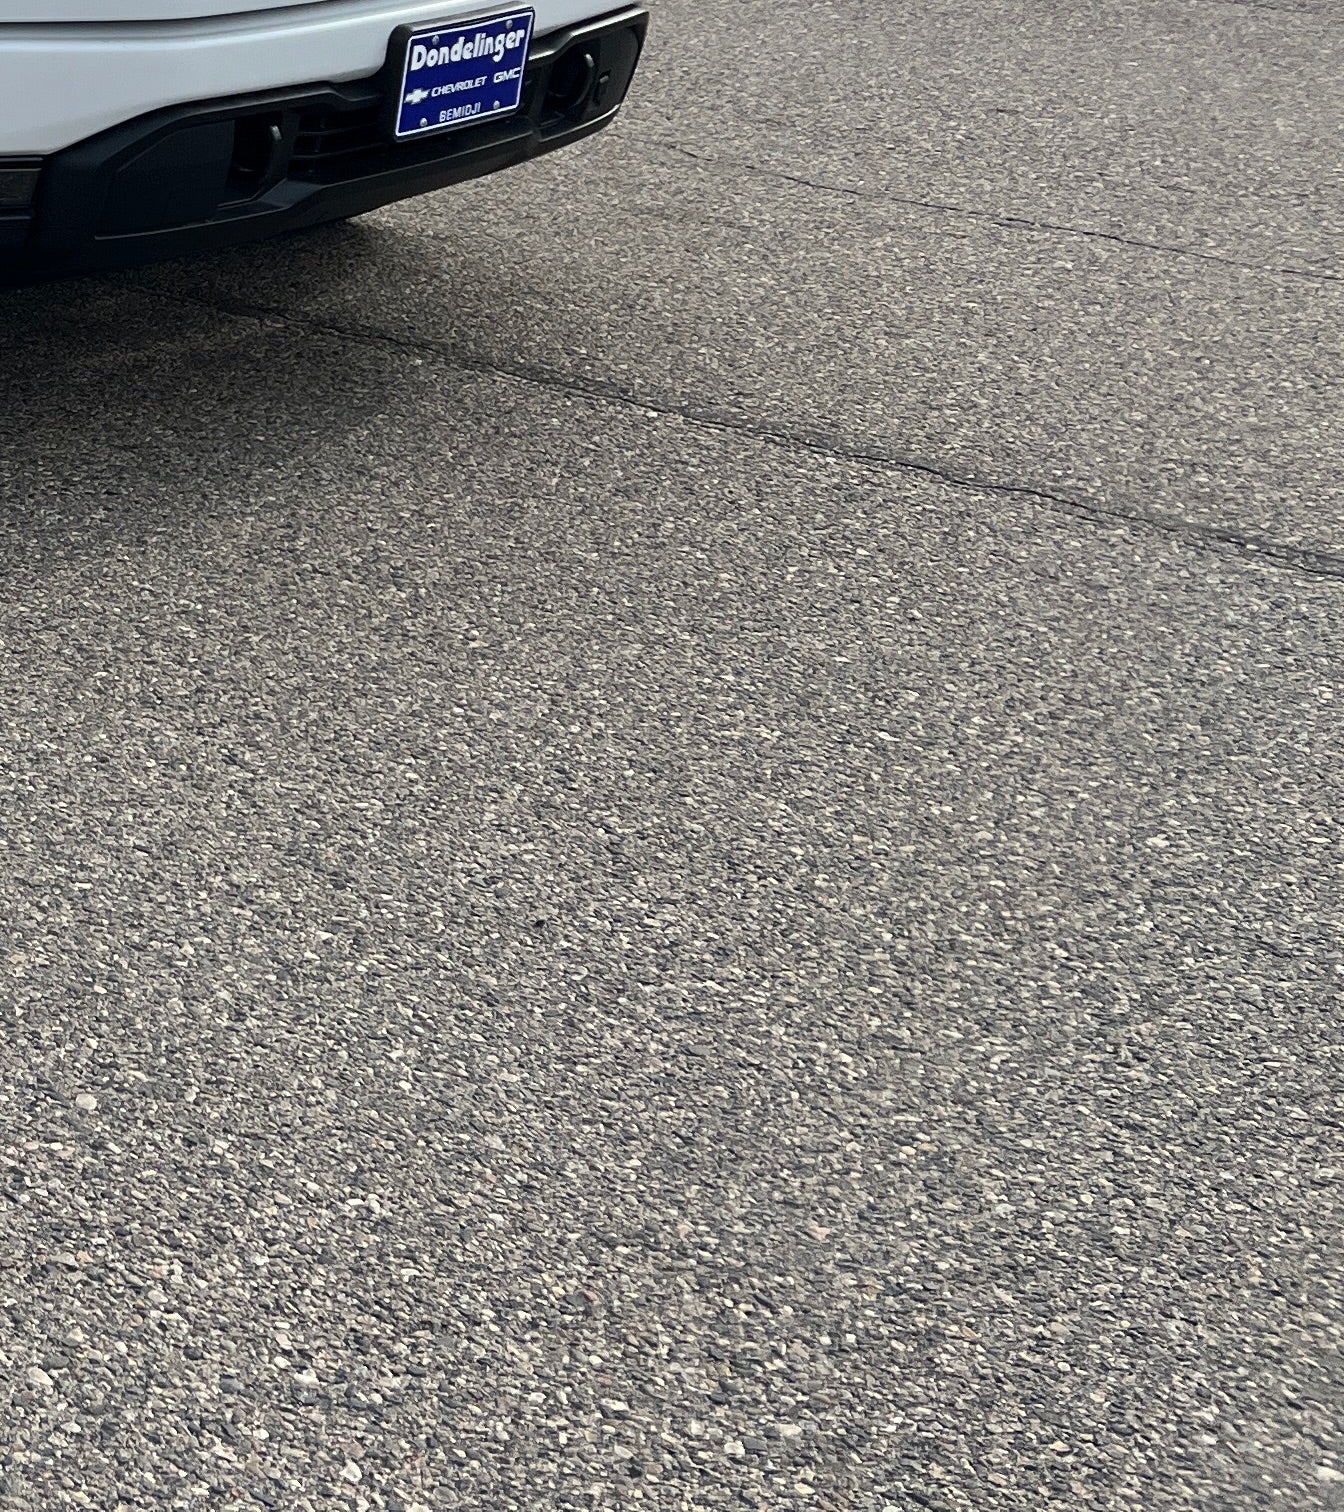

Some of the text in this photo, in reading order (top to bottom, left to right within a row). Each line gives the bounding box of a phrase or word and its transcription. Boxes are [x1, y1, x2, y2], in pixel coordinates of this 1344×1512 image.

[410, 28, 525, 72] Dondelinger
[431, 67, 523, 98] CHEVROLET GMC
[439, 101, 482, 123] BEMIDJI
